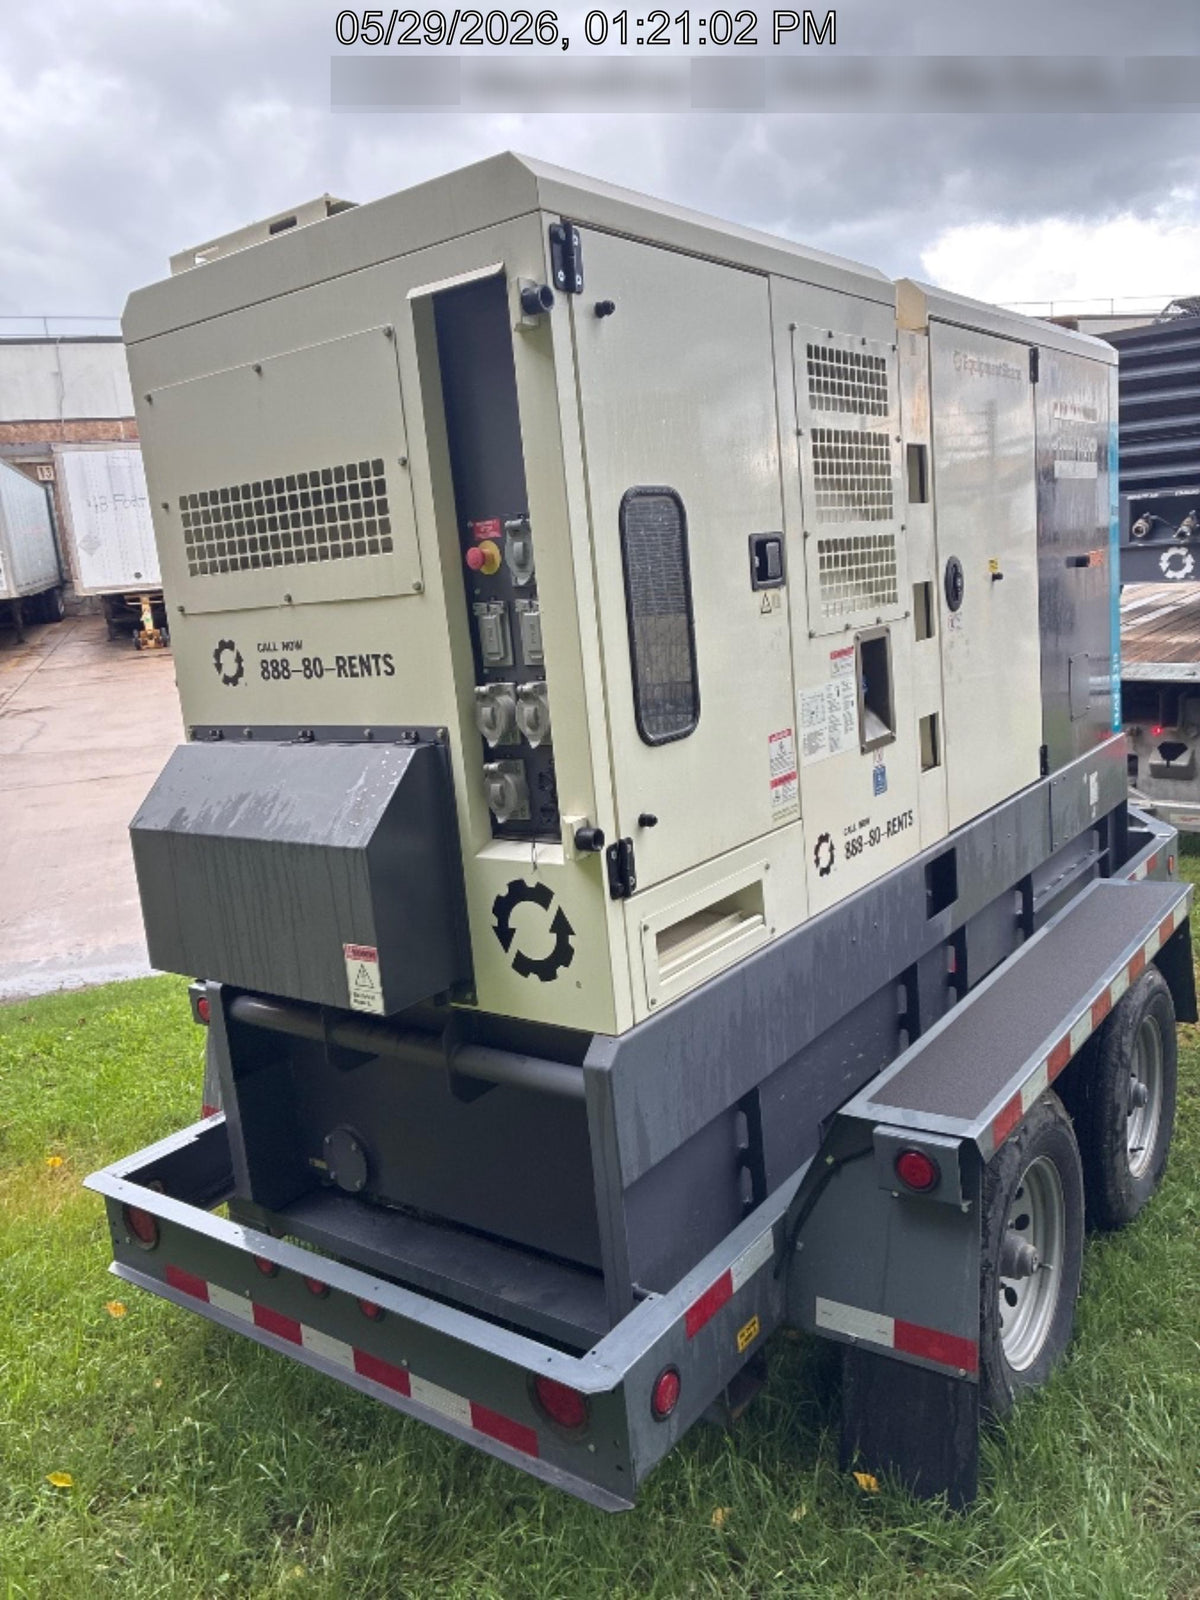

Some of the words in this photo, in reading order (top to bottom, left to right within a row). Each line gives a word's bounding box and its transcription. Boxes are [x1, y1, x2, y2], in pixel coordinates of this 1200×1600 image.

[257, 641, 278, 653] CALL
[282, 640, 303, 652] NOW
[260, 653, 395, 681] 888-80-RENTS
[844, 808, 913, 860] 888-80-RENTS
